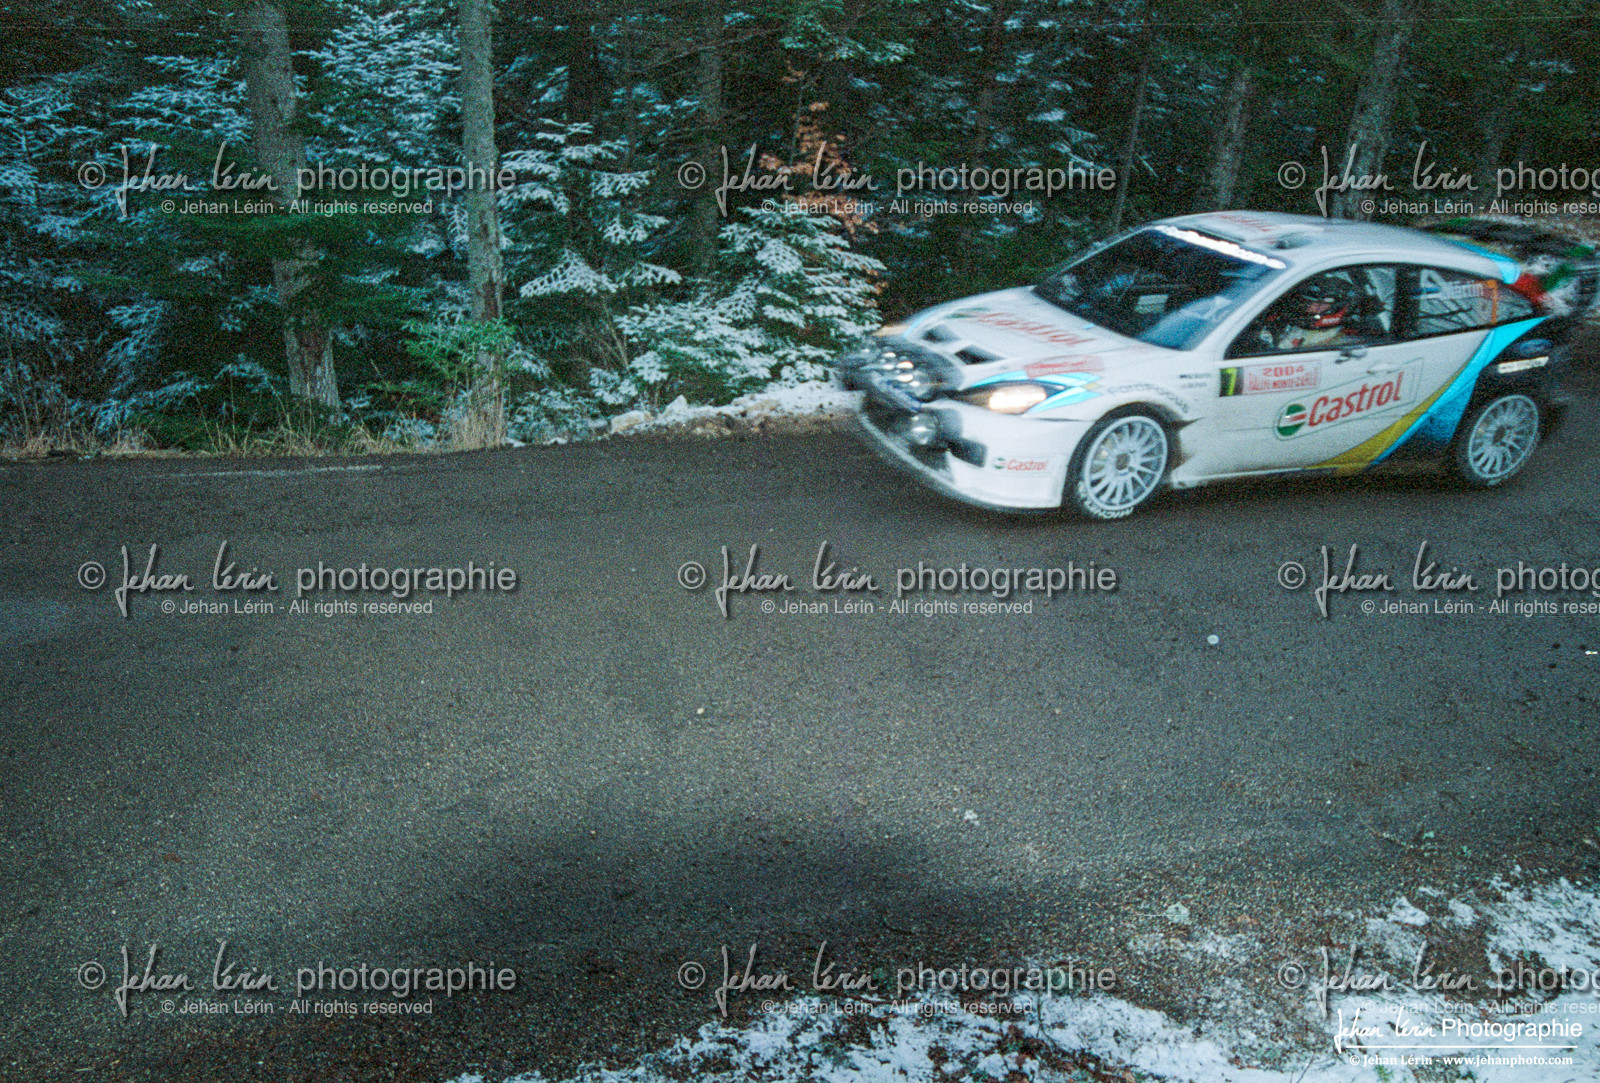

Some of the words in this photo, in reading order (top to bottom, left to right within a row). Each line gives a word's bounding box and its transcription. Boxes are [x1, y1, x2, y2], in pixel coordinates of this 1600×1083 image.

[1262, 365, 1305, 378] 2004
[1307, 370, 1405, 428] Castrol
[1007, 459, 1048, 472] Castrol
